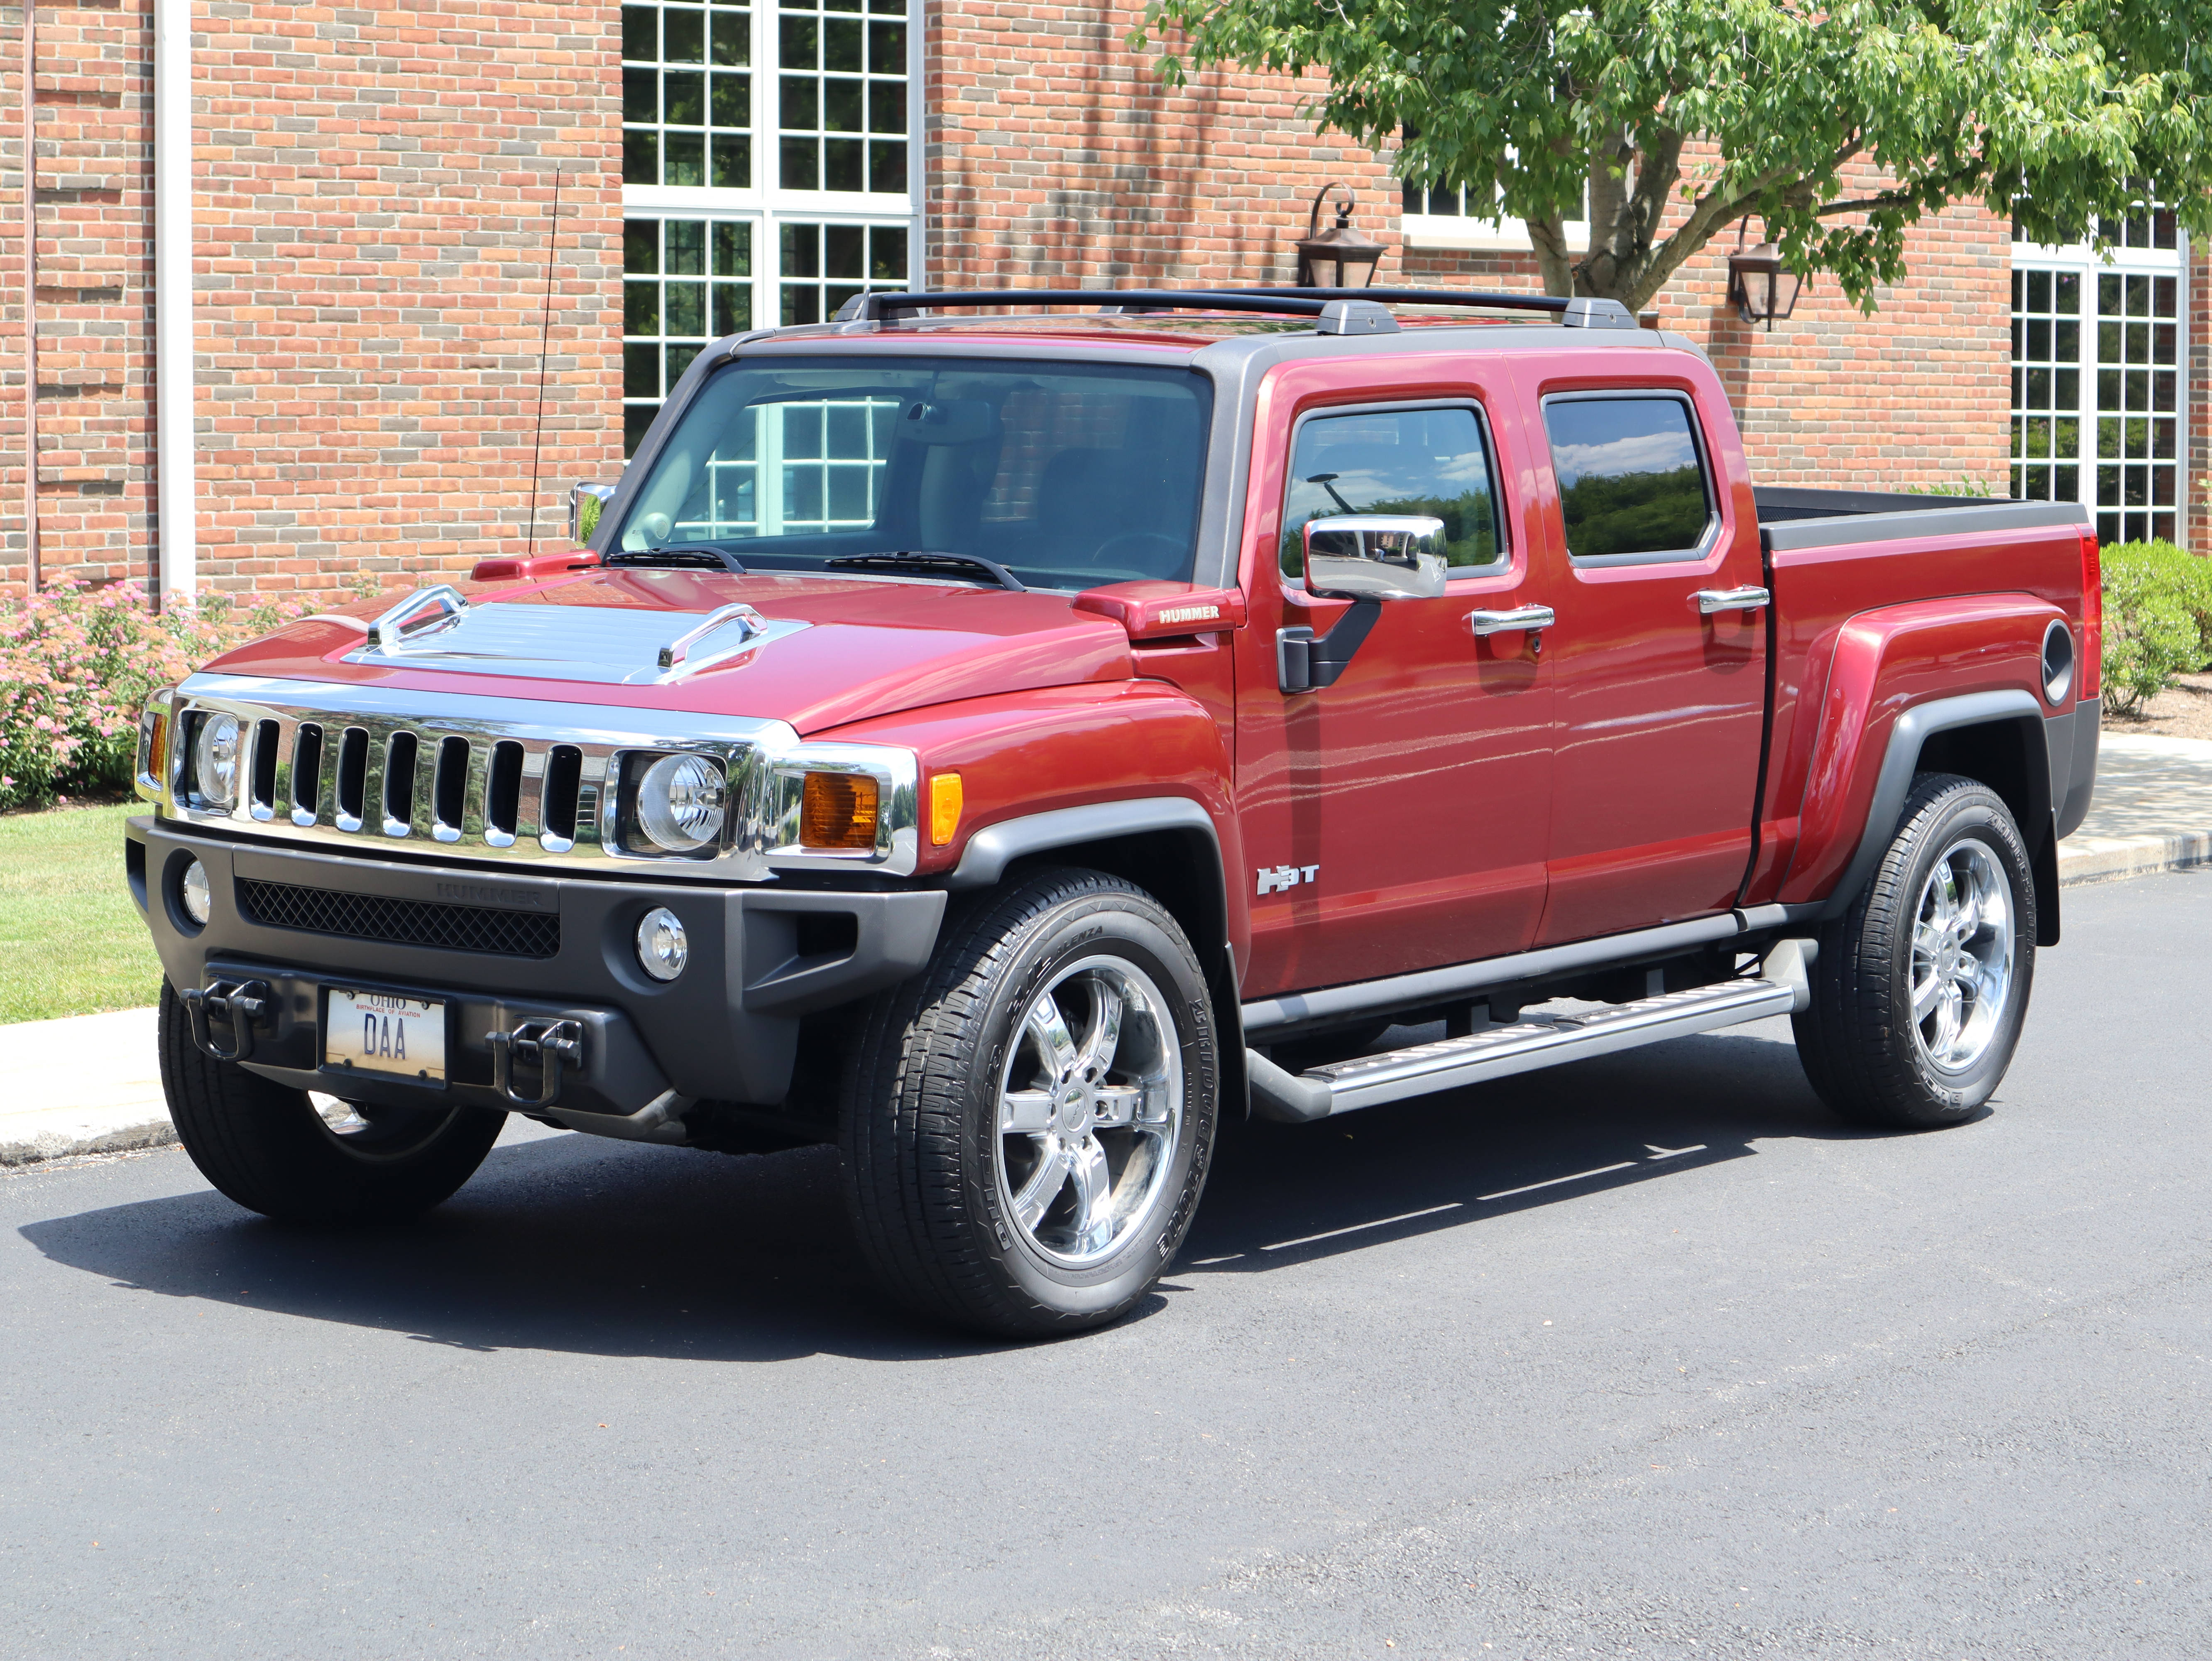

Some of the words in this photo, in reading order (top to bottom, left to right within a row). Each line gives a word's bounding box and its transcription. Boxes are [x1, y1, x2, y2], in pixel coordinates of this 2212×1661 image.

[1159, 605, 1220, 623] HUMMER
[437, 882, 544, 907] HUMMER
[1256, 864, 1320, 895] H3T
[1985, 810, 2036, 966] BRIDGESTONE
[1056, 925, 1104, 956] ALENZA
[356, 1004, 385, 1013] BIRTHPLACE
[370, 994, 406, 1009] OHIO
[364, 1013, 406, 1060] DAA
[1157, 998, 1214, 1258] BRIDGESTONE
